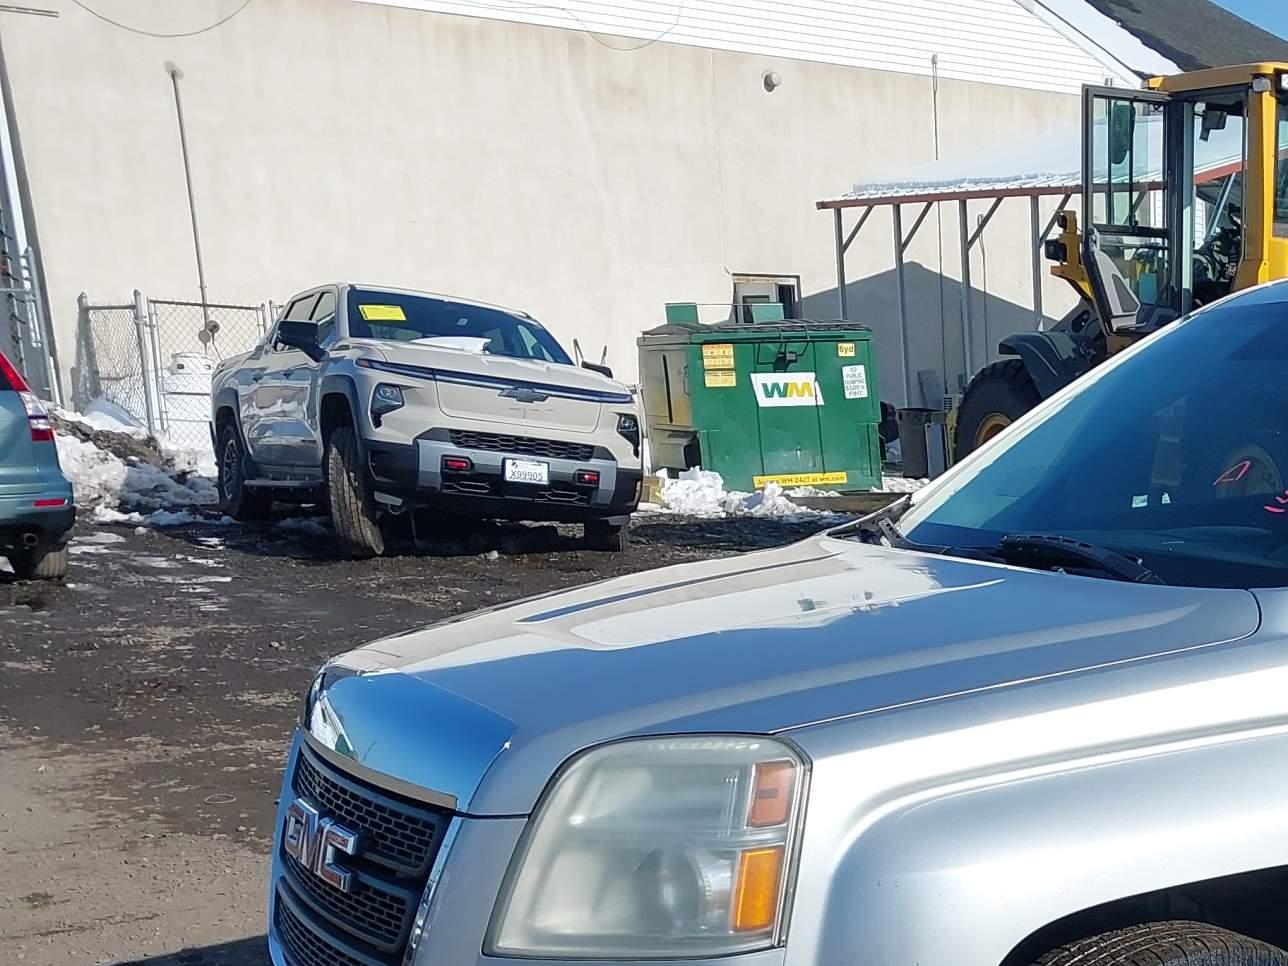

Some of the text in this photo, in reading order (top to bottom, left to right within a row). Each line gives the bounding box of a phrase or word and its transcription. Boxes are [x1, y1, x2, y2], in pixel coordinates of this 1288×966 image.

[839, 344, 854, 355] 6yd
[761, 382, 814, 399] WM
[284, 798, 358, 894] GMC
